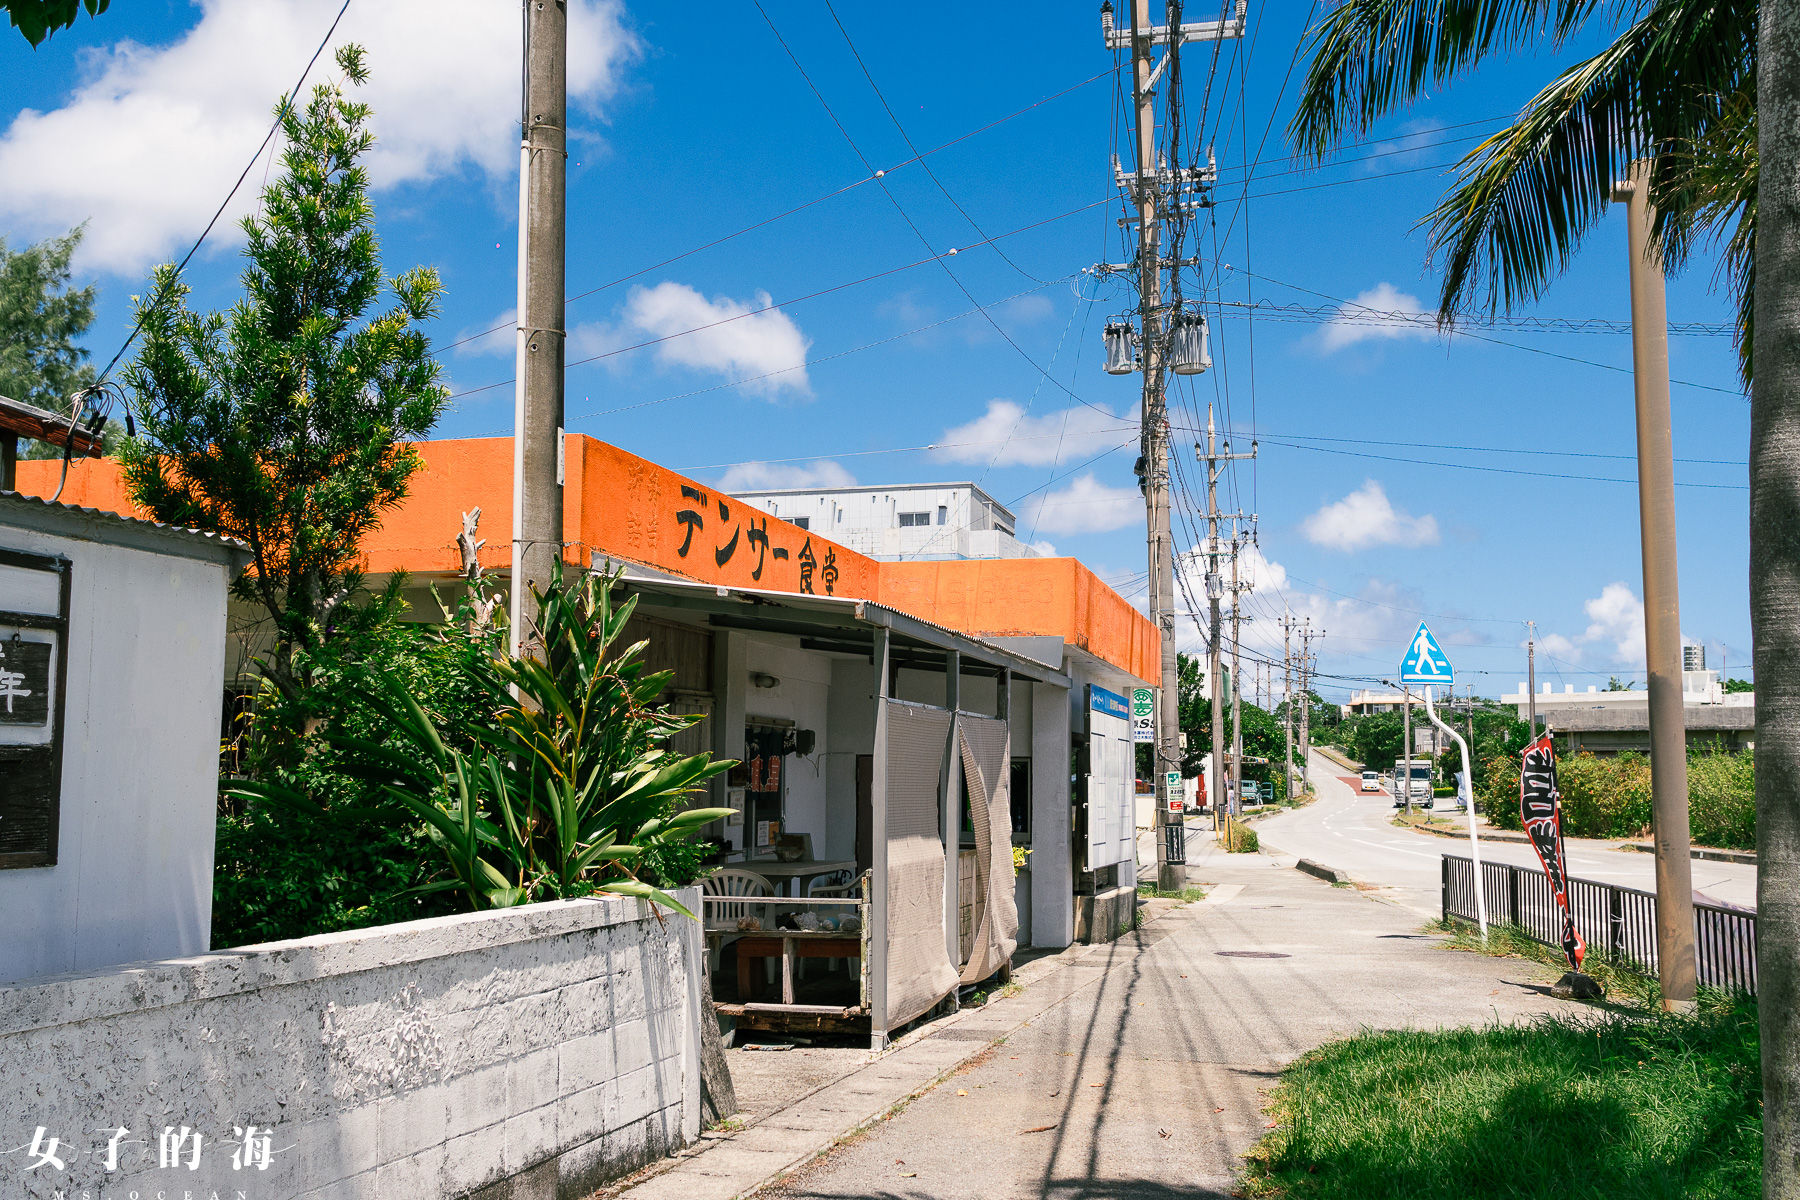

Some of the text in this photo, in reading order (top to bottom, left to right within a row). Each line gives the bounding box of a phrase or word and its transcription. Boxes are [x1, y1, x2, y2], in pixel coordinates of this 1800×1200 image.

[676, 484, 839, 597] デンサー食堂
